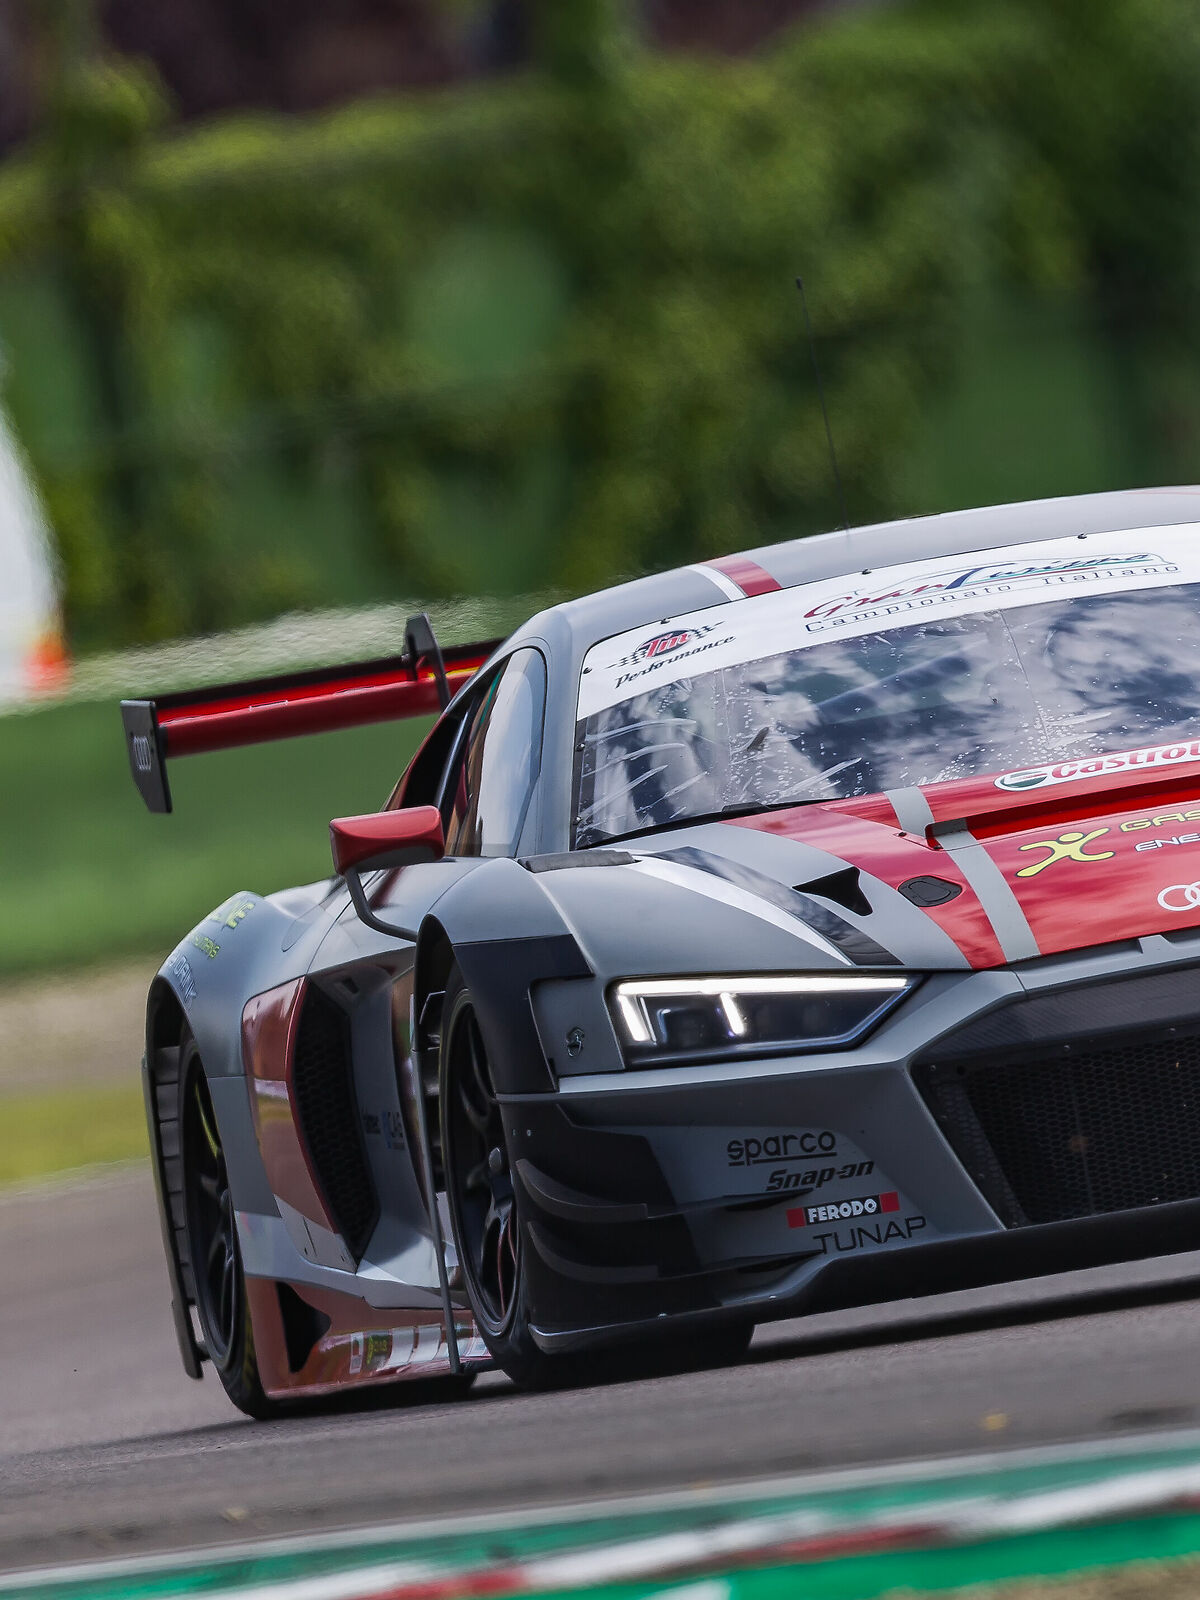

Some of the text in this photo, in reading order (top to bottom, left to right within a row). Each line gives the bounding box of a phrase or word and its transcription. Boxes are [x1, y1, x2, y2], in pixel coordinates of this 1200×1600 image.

[805, 565, 1180, 633] Campionato Italiano
[615, 636, 737, 689] Performance
[727, 1131, 836, 1166] sparco
[766, 1160, 875, 1191] Snap-on
[807, 1198, 878, 1223] FERODO
[812, 1215, 927, 1255] TUNAP
